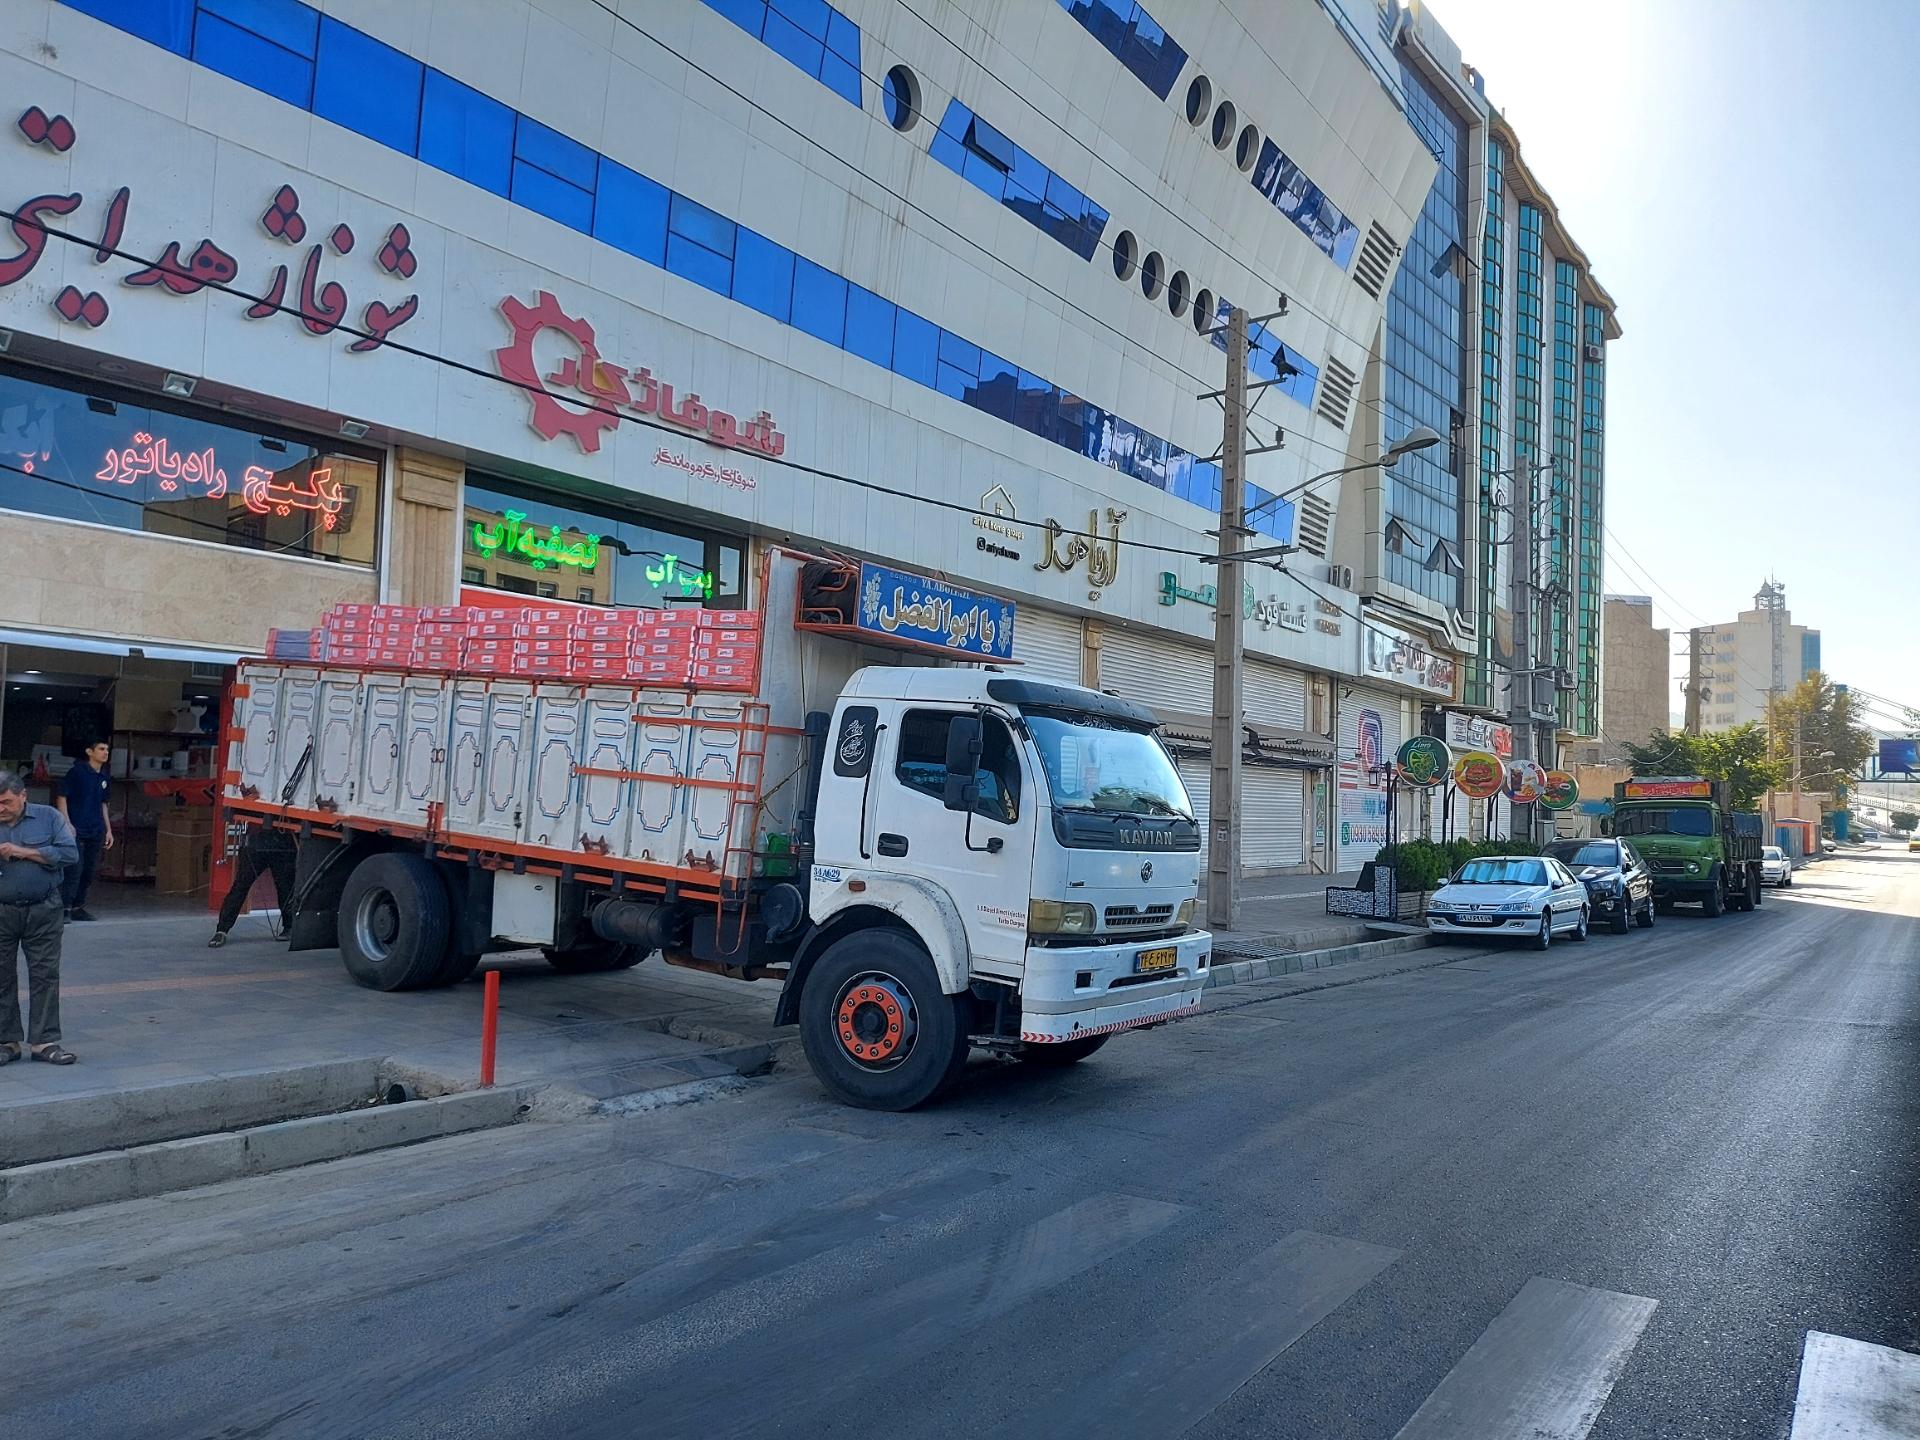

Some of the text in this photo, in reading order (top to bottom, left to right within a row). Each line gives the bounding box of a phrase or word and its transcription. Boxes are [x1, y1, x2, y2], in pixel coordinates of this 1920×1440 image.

[244, 183, 420, 352] شوفاژ
[96, 431, 344, 531] پکیج رادیاتور
[473, 509, 601, 570] تصفیه آب
[878, 585, 996, 653] یا ابوالفضل
[1119, 829, 1172, 845] KAVIAN
